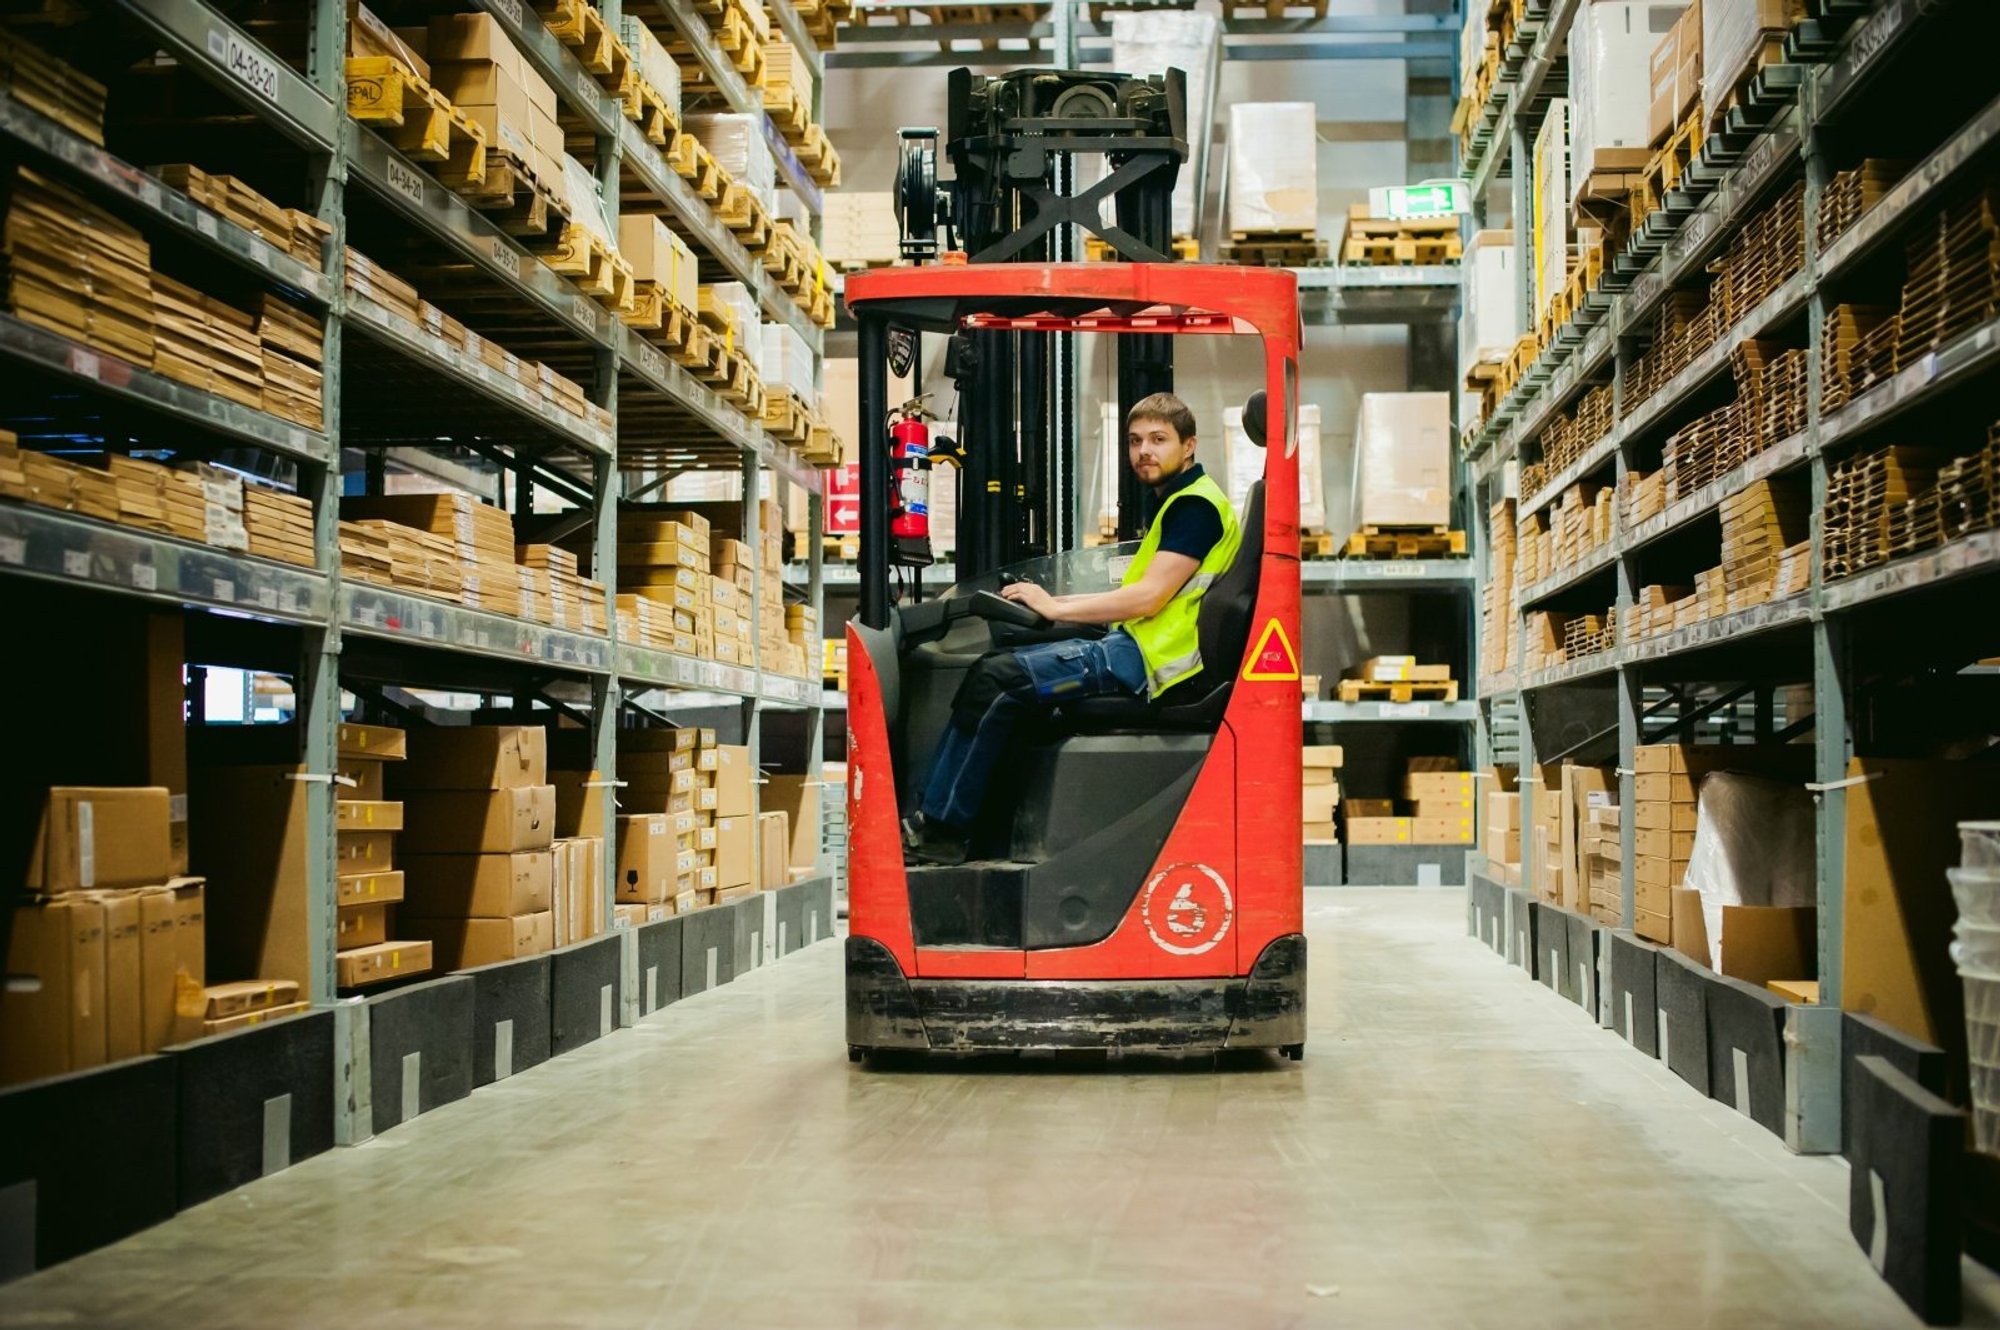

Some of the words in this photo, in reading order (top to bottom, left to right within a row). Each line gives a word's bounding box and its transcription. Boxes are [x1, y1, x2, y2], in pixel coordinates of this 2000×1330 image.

[231, 42, 275, 97] 04-33-20
[390, 163, 421, 200] 04-34-20
[1167, 883, 1206, 938] 6
